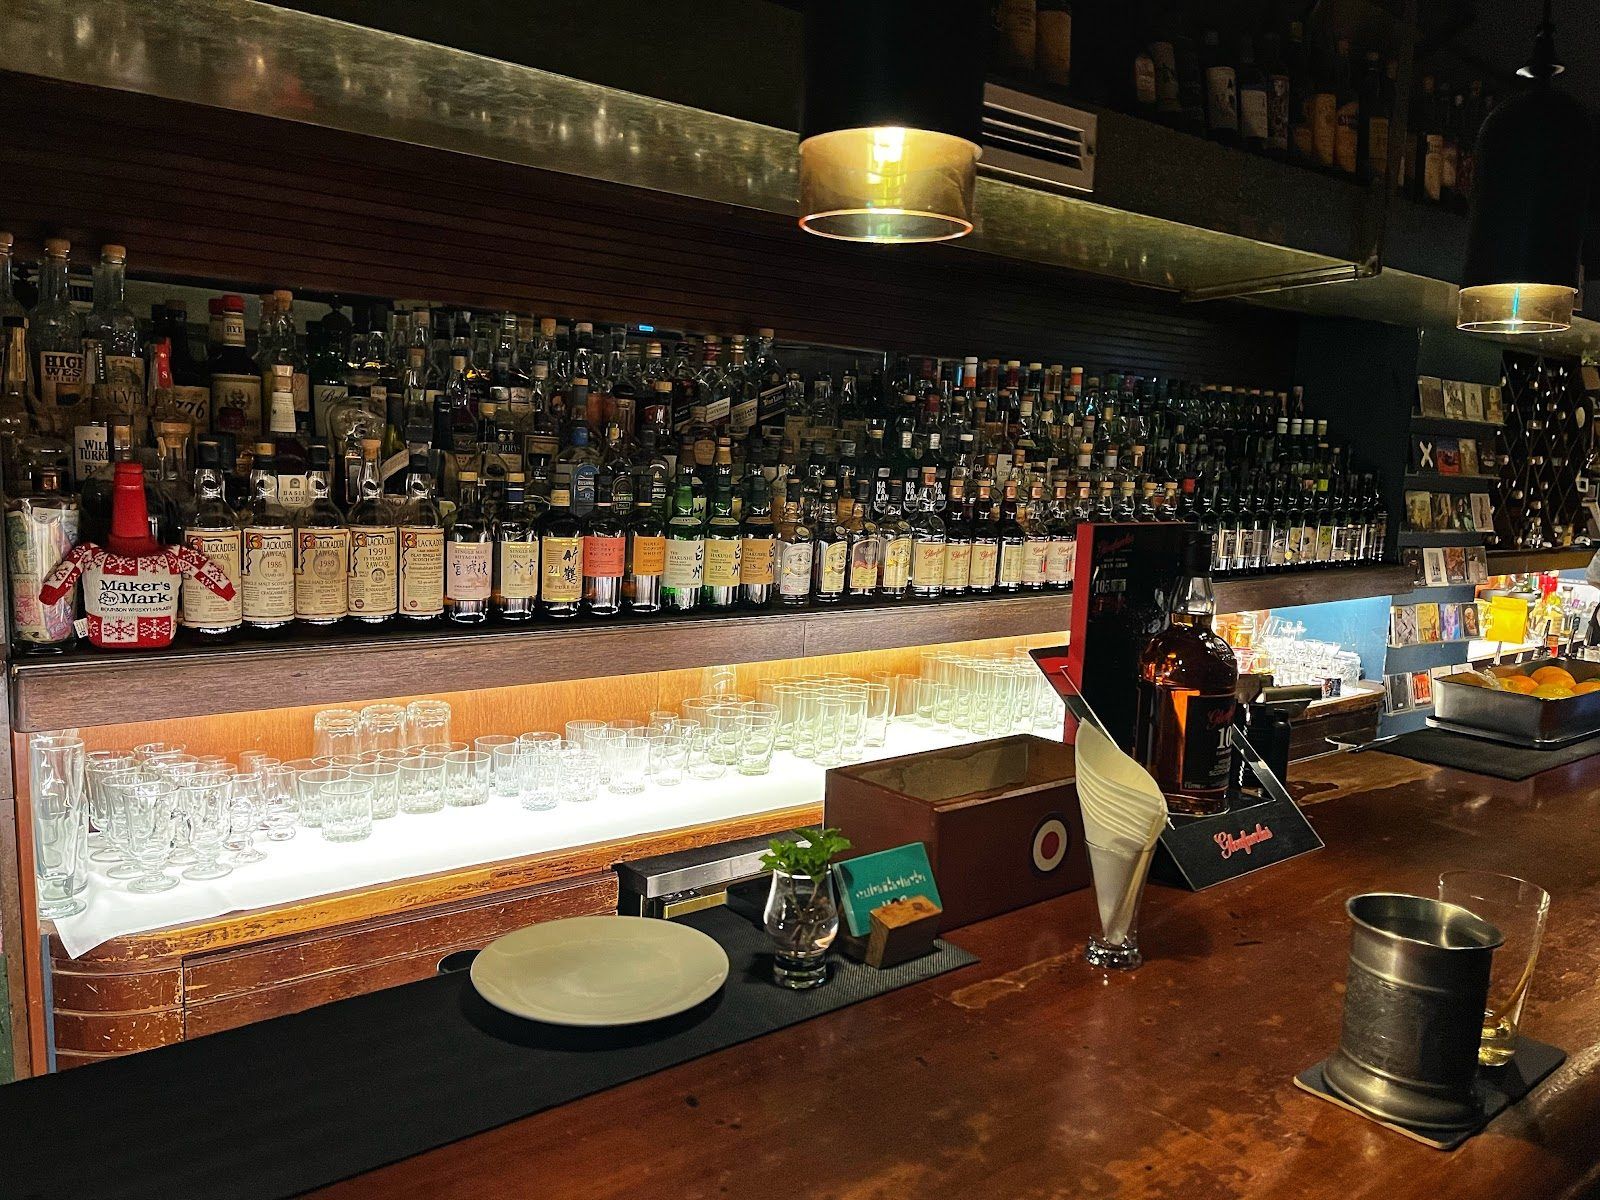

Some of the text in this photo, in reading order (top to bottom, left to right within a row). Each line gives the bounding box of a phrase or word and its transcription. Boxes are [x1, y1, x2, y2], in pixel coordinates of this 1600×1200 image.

[46, 369, 82, 377] WES
[368, 547, 387, 556] 1991
[99, 579, 171, 592] Maker's
[119, 592, 170, 605] Mark
